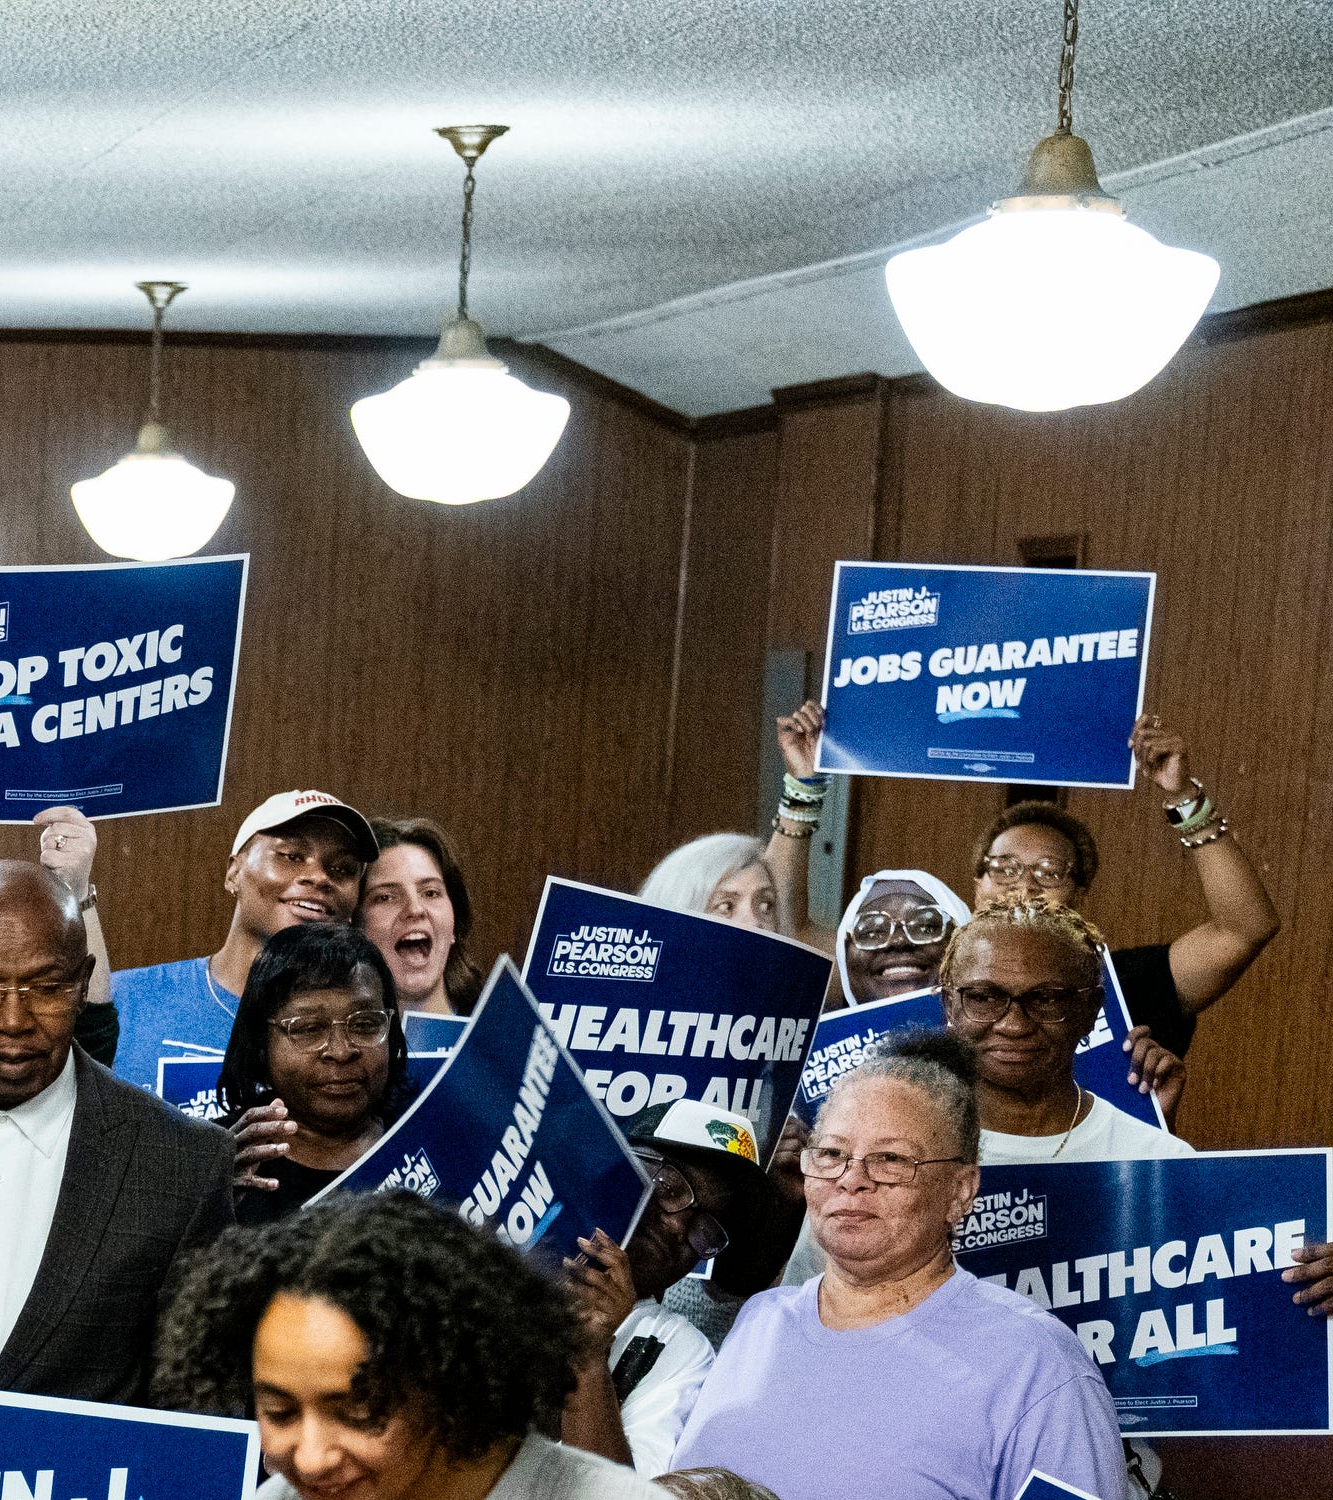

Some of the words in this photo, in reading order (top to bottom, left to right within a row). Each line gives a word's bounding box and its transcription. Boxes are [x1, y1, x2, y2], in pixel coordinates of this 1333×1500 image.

[852, 599, 937, 619] PEARSON
[861, 588, 913, 606] JUSTIN
[58, 625, 184, 688] TOXIC
[834, 651, 922, 687] JOBS
[928, 629, 1138, 677] GUARANTEE
[31, 667, 214, 743] CENTERS
[936, 678, 1027, 715] NOW
[570, 926, 631, 943] JUSTIN
[554, 941, 658, 966] PEARSON
[539, 1003, 810, 1062] HEALTHCARE
[808, 1034, 861, 1067] JUSTIN
[802, 1037, 888, 1088] PEARSO
[954, 1202, 1043, 1237] EARSON
[964, 1192, 1011, 1215] STIN
[980, 1219, 1305, 1310] ALTHCARE
[1129, 1298, 1237, 1359] ALL
